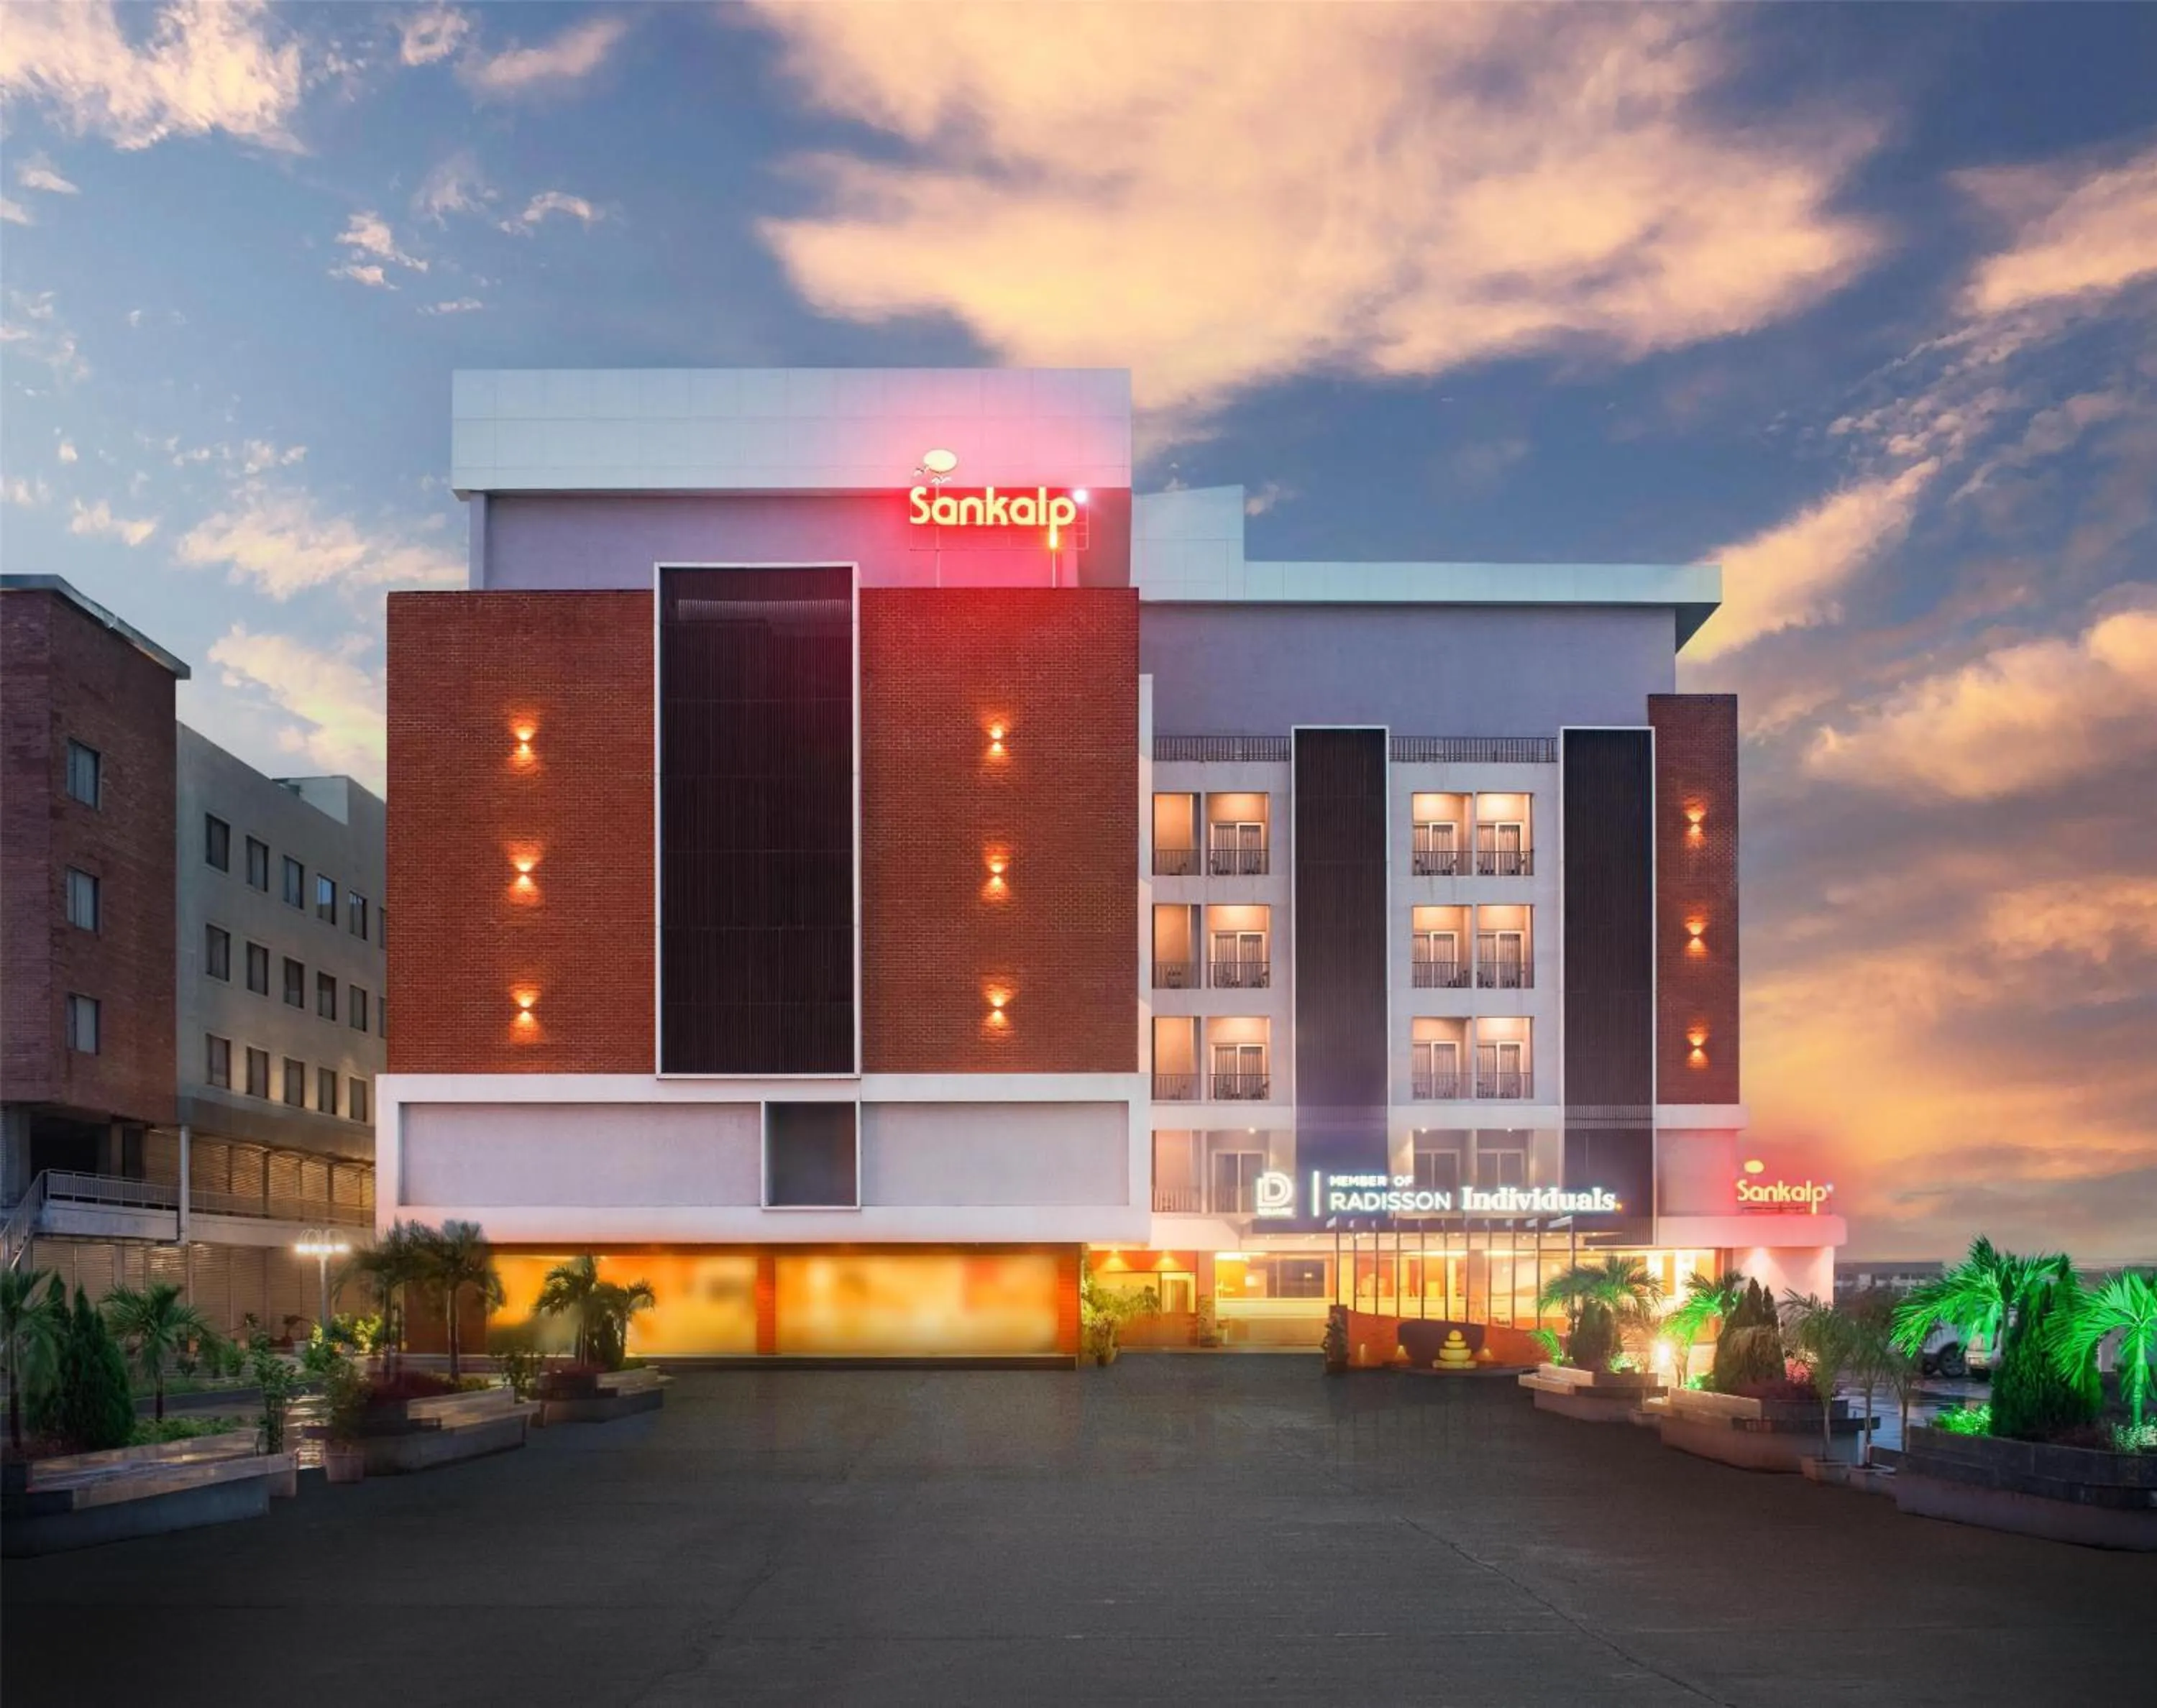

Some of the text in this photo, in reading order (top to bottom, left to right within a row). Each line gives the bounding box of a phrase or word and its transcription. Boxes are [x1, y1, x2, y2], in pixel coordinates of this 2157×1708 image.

[910, 487, 1076, 549] Sankalp
[1329, 1175, 1414, 1185] MEMBER OF
[1330, 1192, 1451, 1211] RADISSON
[1737, 1179, 1827, 1214] Sankalp
